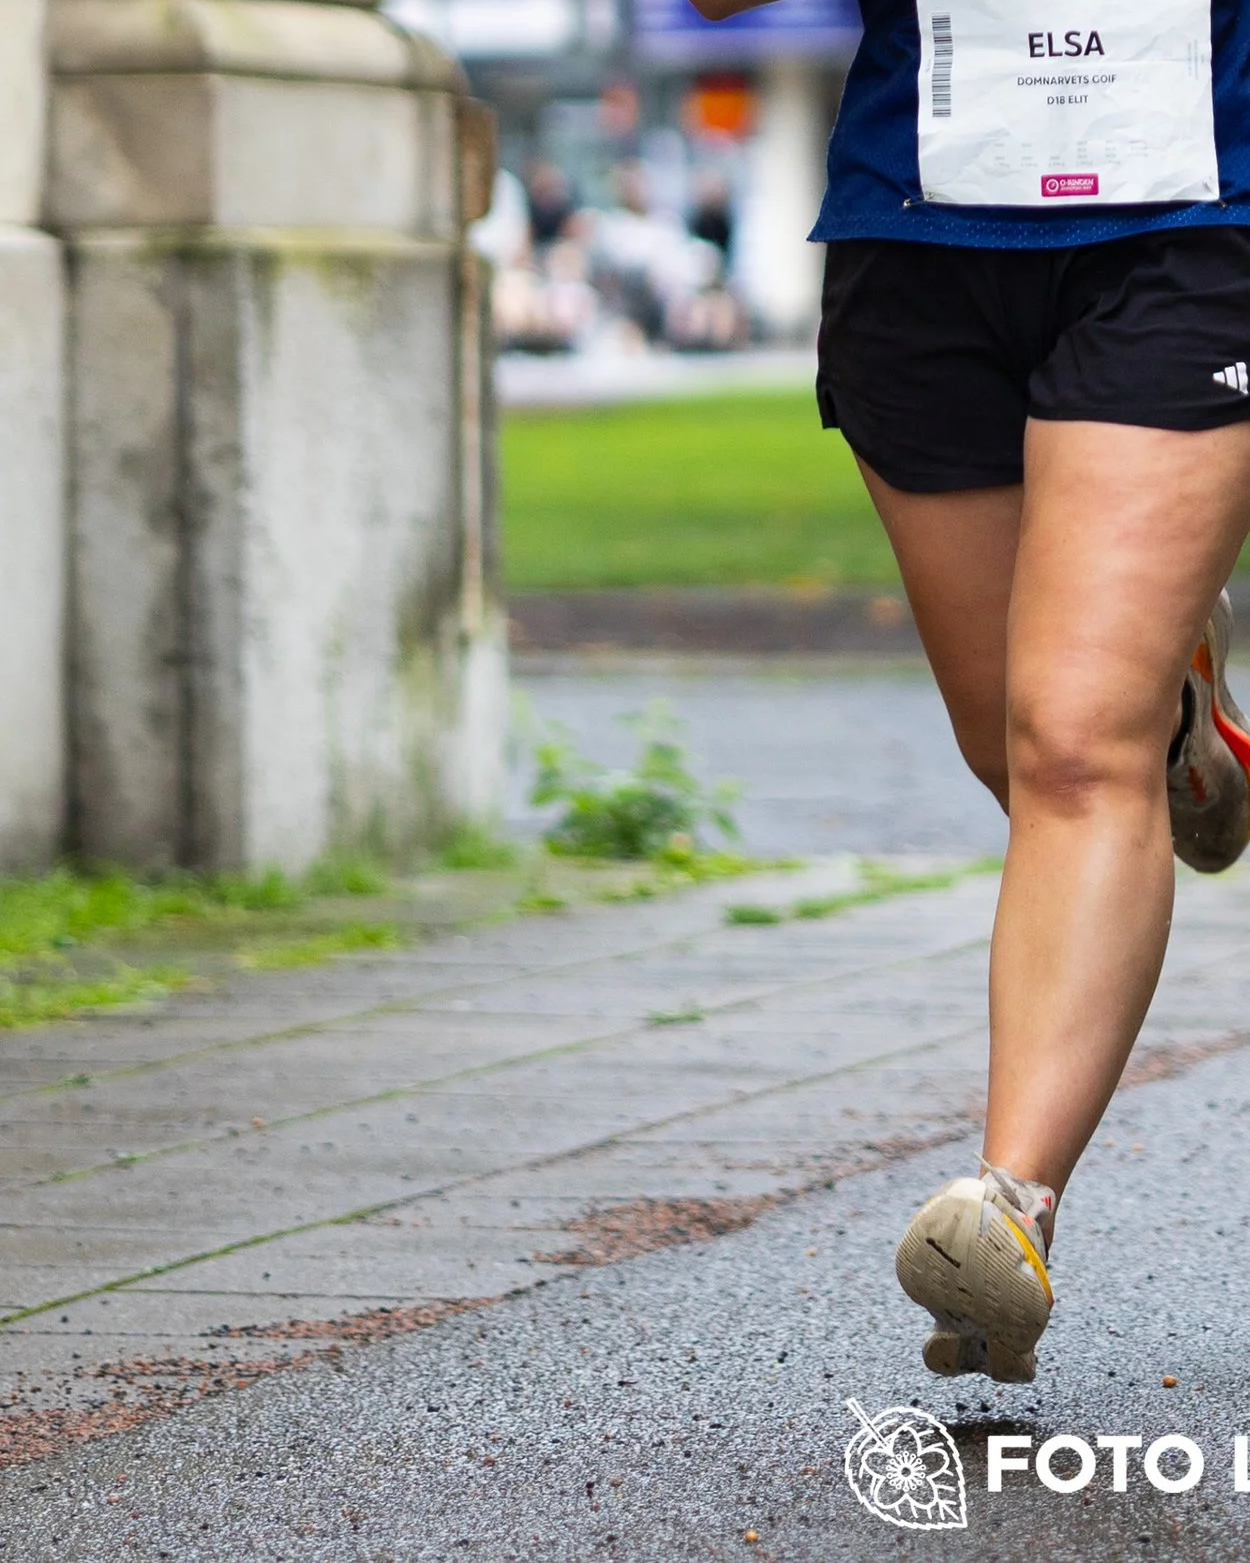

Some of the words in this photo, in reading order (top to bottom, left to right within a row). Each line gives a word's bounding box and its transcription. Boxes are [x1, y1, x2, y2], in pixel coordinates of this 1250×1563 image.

[1028, 30, 1105, 59] ELSA
[1017, 75, 1090, 86] DOMNARVETS
[1092, 74, 1117, 84] GOIF
[1046, 96, 1066, 105] D18
[1068, 94, 1089, 104] ELIT
